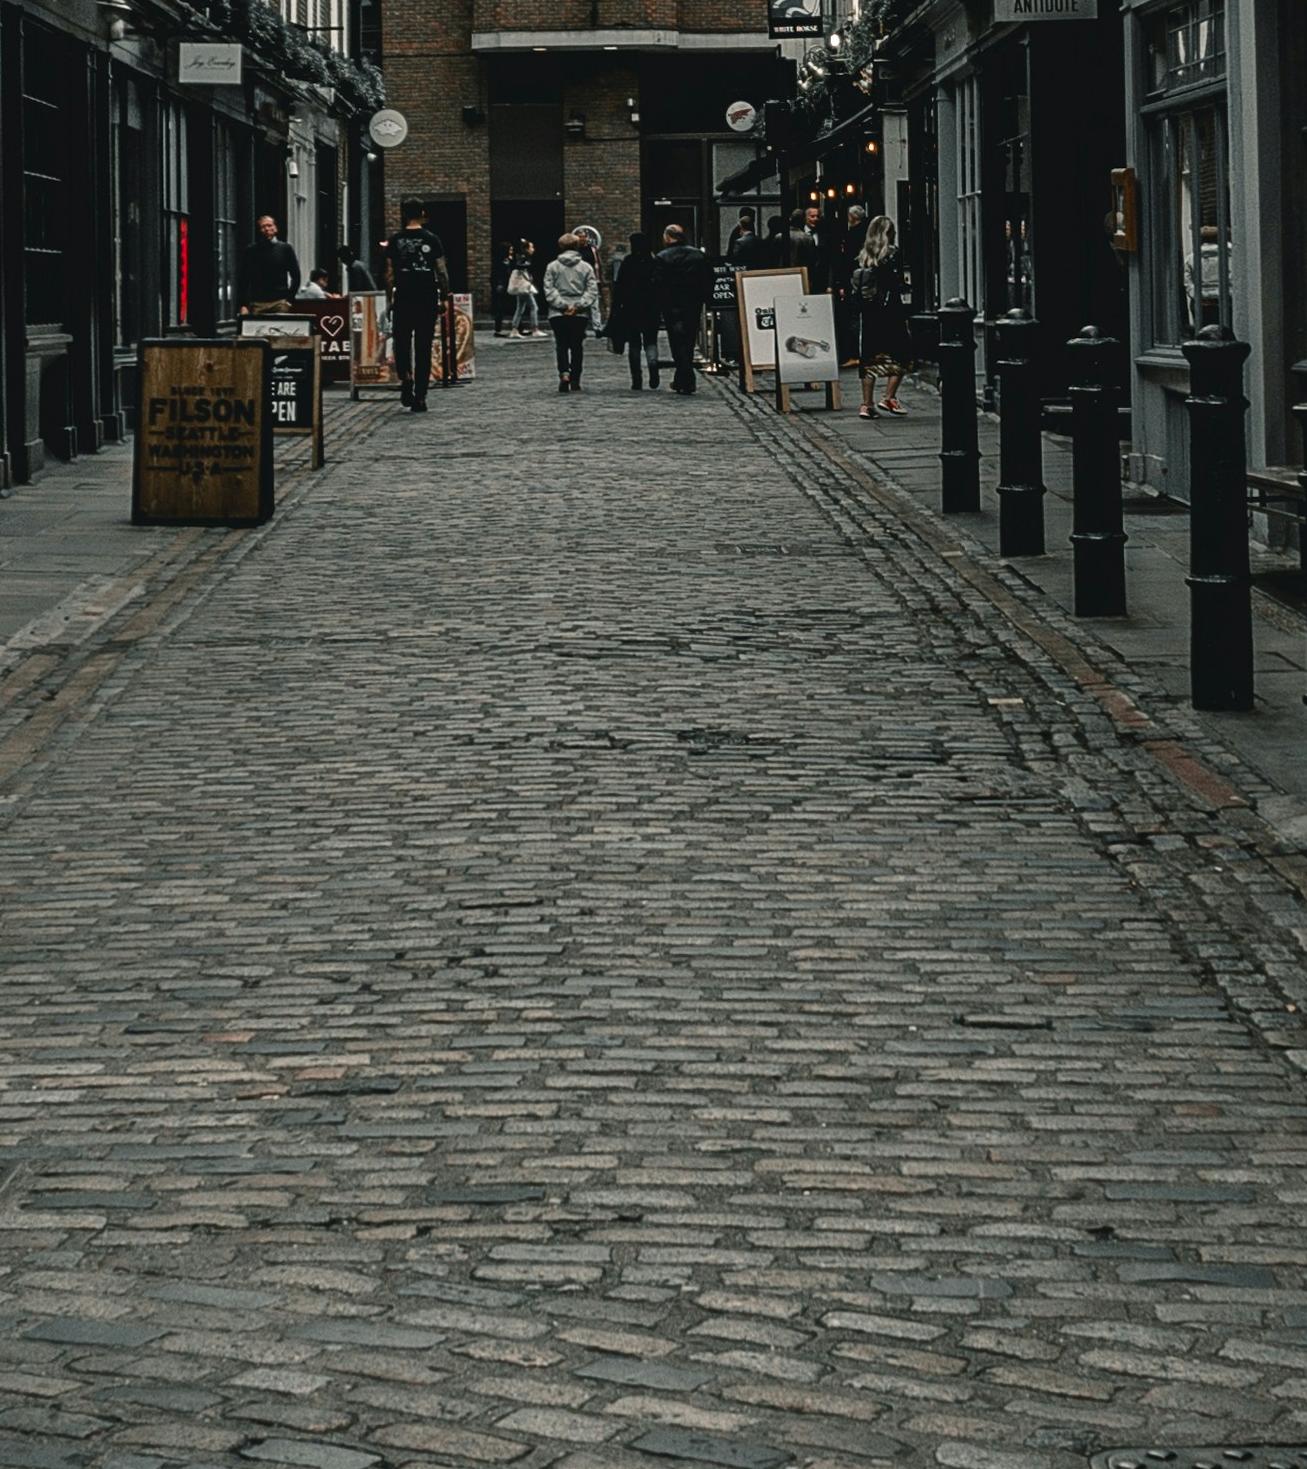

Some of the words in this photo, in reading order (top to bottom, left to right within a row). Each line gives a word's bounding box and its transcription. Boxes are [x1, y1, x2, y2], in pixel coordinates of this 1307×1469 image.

[774, 25, 794, 33] WHITE
[796, 24, 818, 33] HORSE
[714, 283, 730, 291] BAR
[713, 292, 735, 300] OPEN
[277, 382, 296, 396] ARE
[149, 398, 255, 425] FILSON
[165, 426, 239, 441] SEATTLE
[149, 444, 254, 459] WASHINGTON
